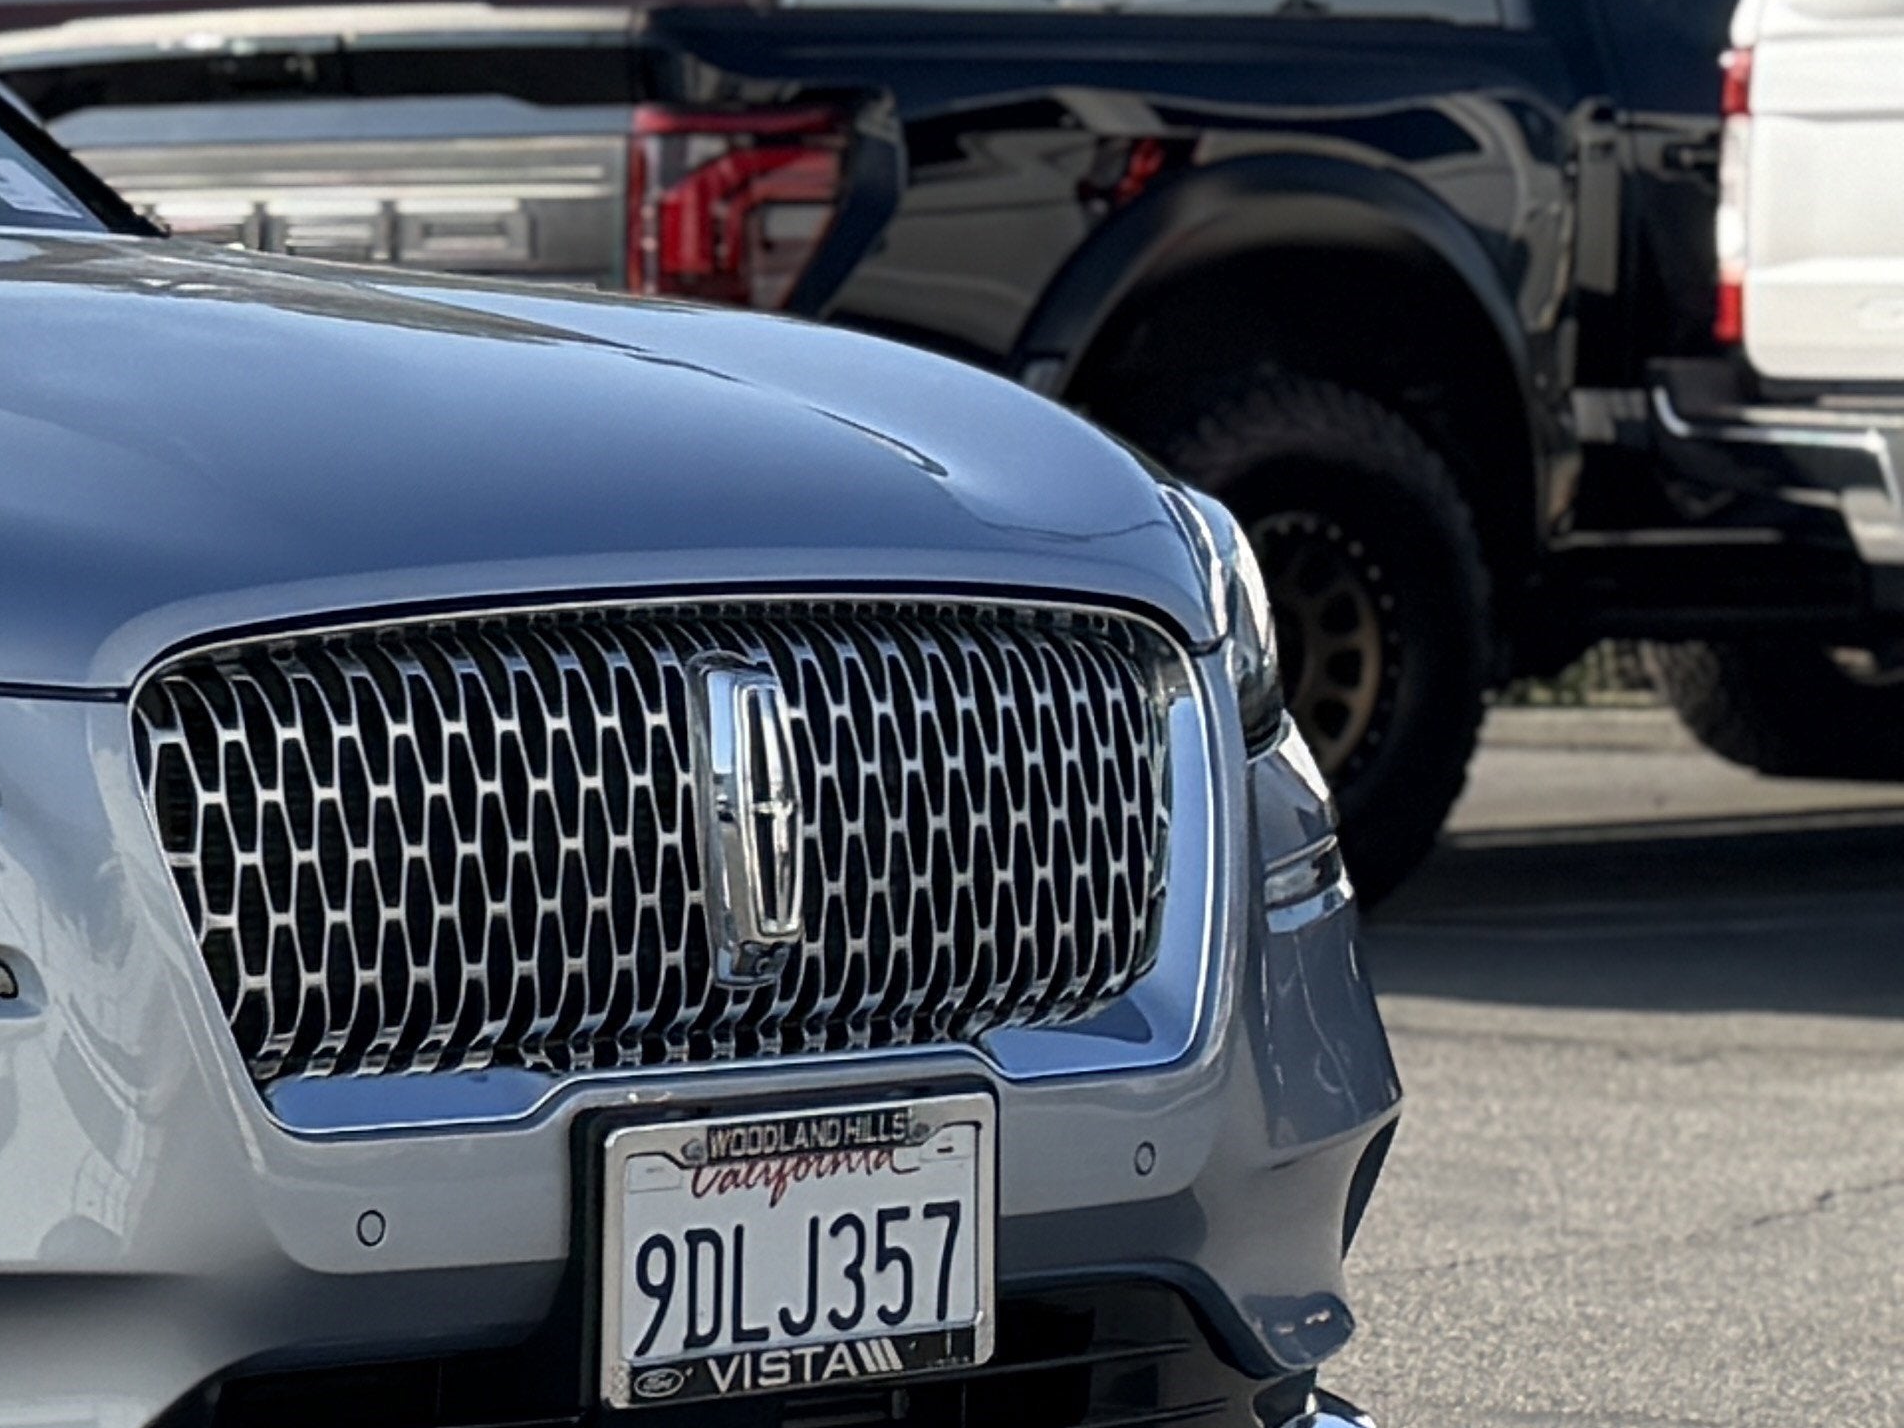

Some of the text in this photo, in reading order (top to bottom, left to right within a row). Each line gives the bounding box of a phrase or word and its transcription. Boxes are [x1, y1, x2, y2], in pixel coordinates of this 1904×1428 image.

[692, 1148, 921, 1209] California
[634, 1199, 962, 1357] 9DLJ357
[708, 1342, 858, 1394] VISTA
